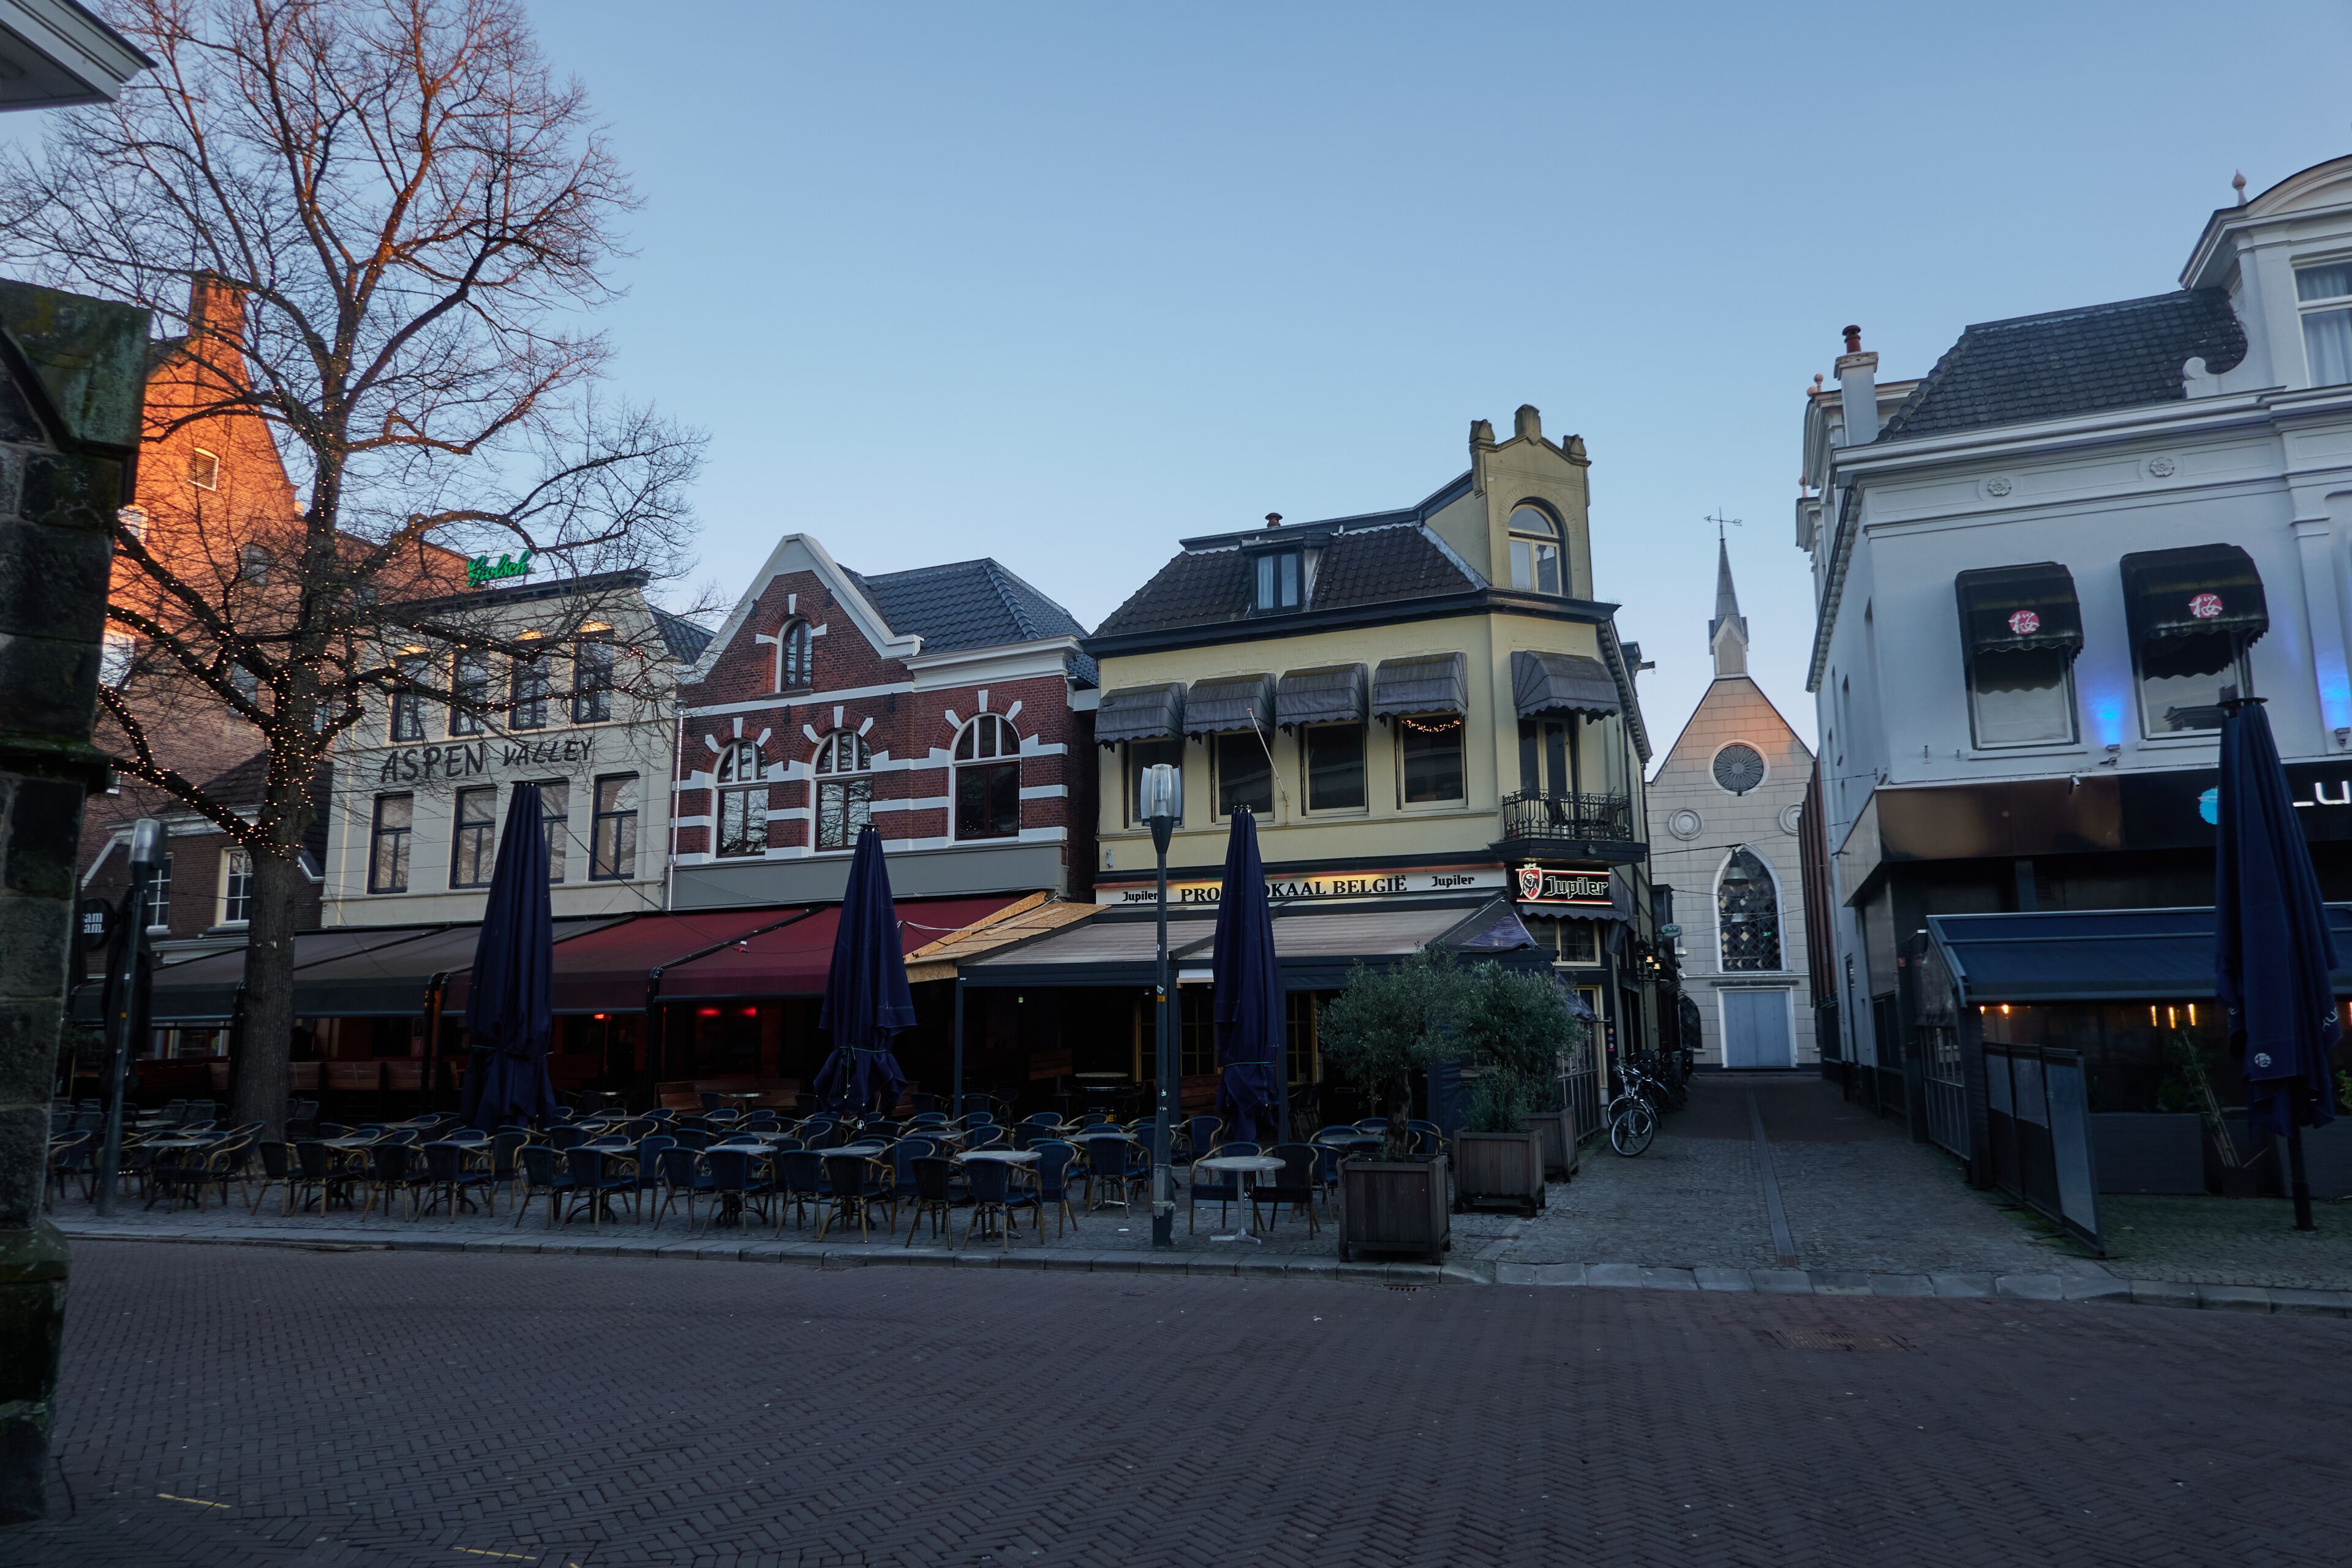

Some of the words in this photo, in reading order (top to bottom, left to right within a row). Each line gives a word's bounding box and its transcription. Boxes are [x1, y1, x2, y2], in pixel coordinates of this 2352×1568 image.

[380, 742, 484, 783] ASPEN
[502, 736, 592, 766] VALLEY
[1333, 875, 1407, 894] BELGIË
[1431, 875, 1475, 888] Jupiler
[1543, 876, 1608, 899] Jupiler
[82, 913, 103, 923] am
